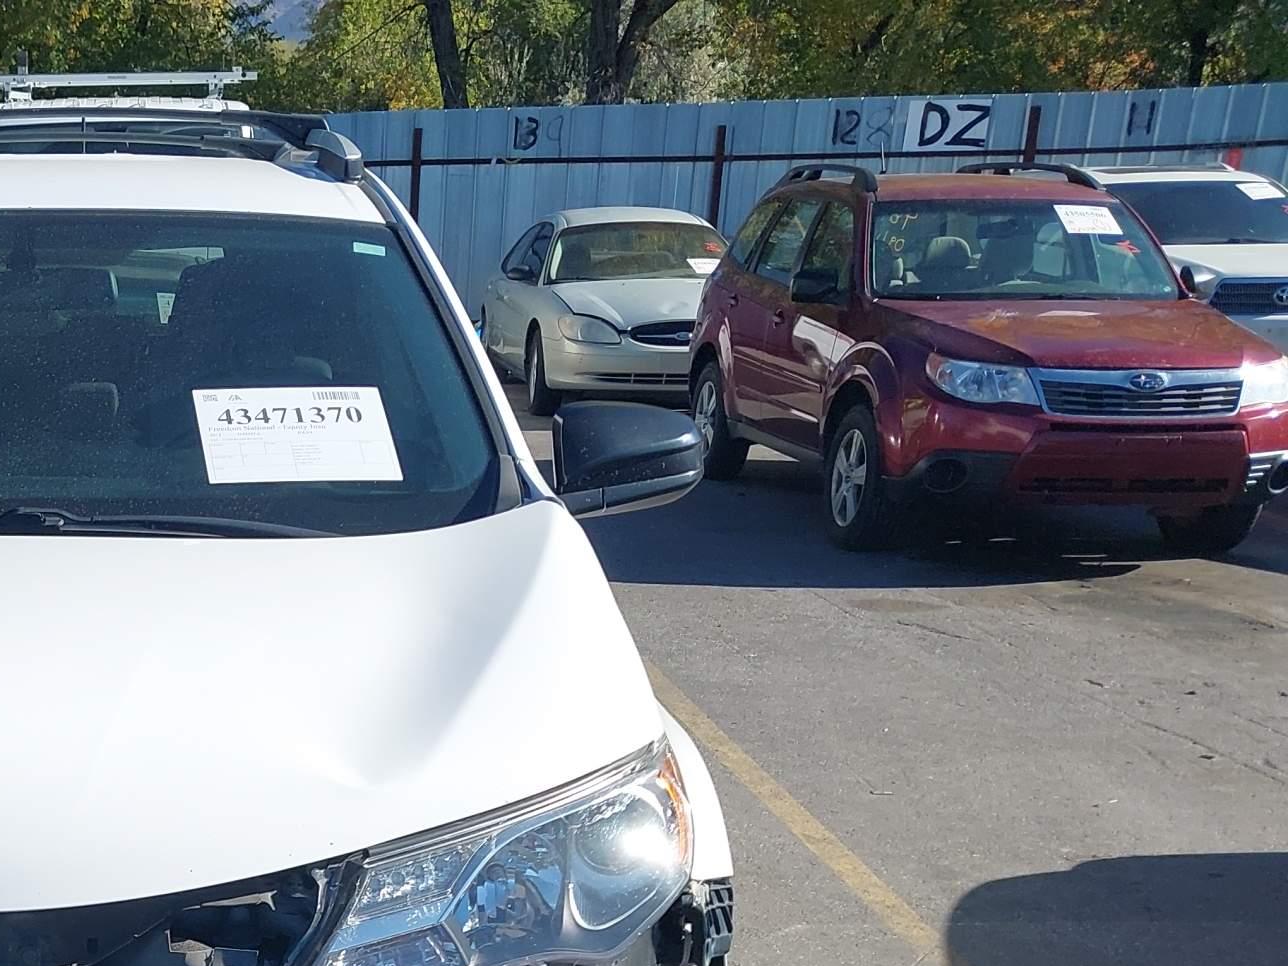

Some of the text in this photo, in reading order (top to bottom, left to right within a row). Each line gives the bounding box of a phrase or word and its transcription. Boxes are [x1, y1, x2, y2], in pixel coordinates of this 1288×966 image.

[513, 116, 539, 150] 13
[831, 108, 861, 146] 12
[917, 101, 991, 148] DZ
[217, 406, 362, 425] 43471370
